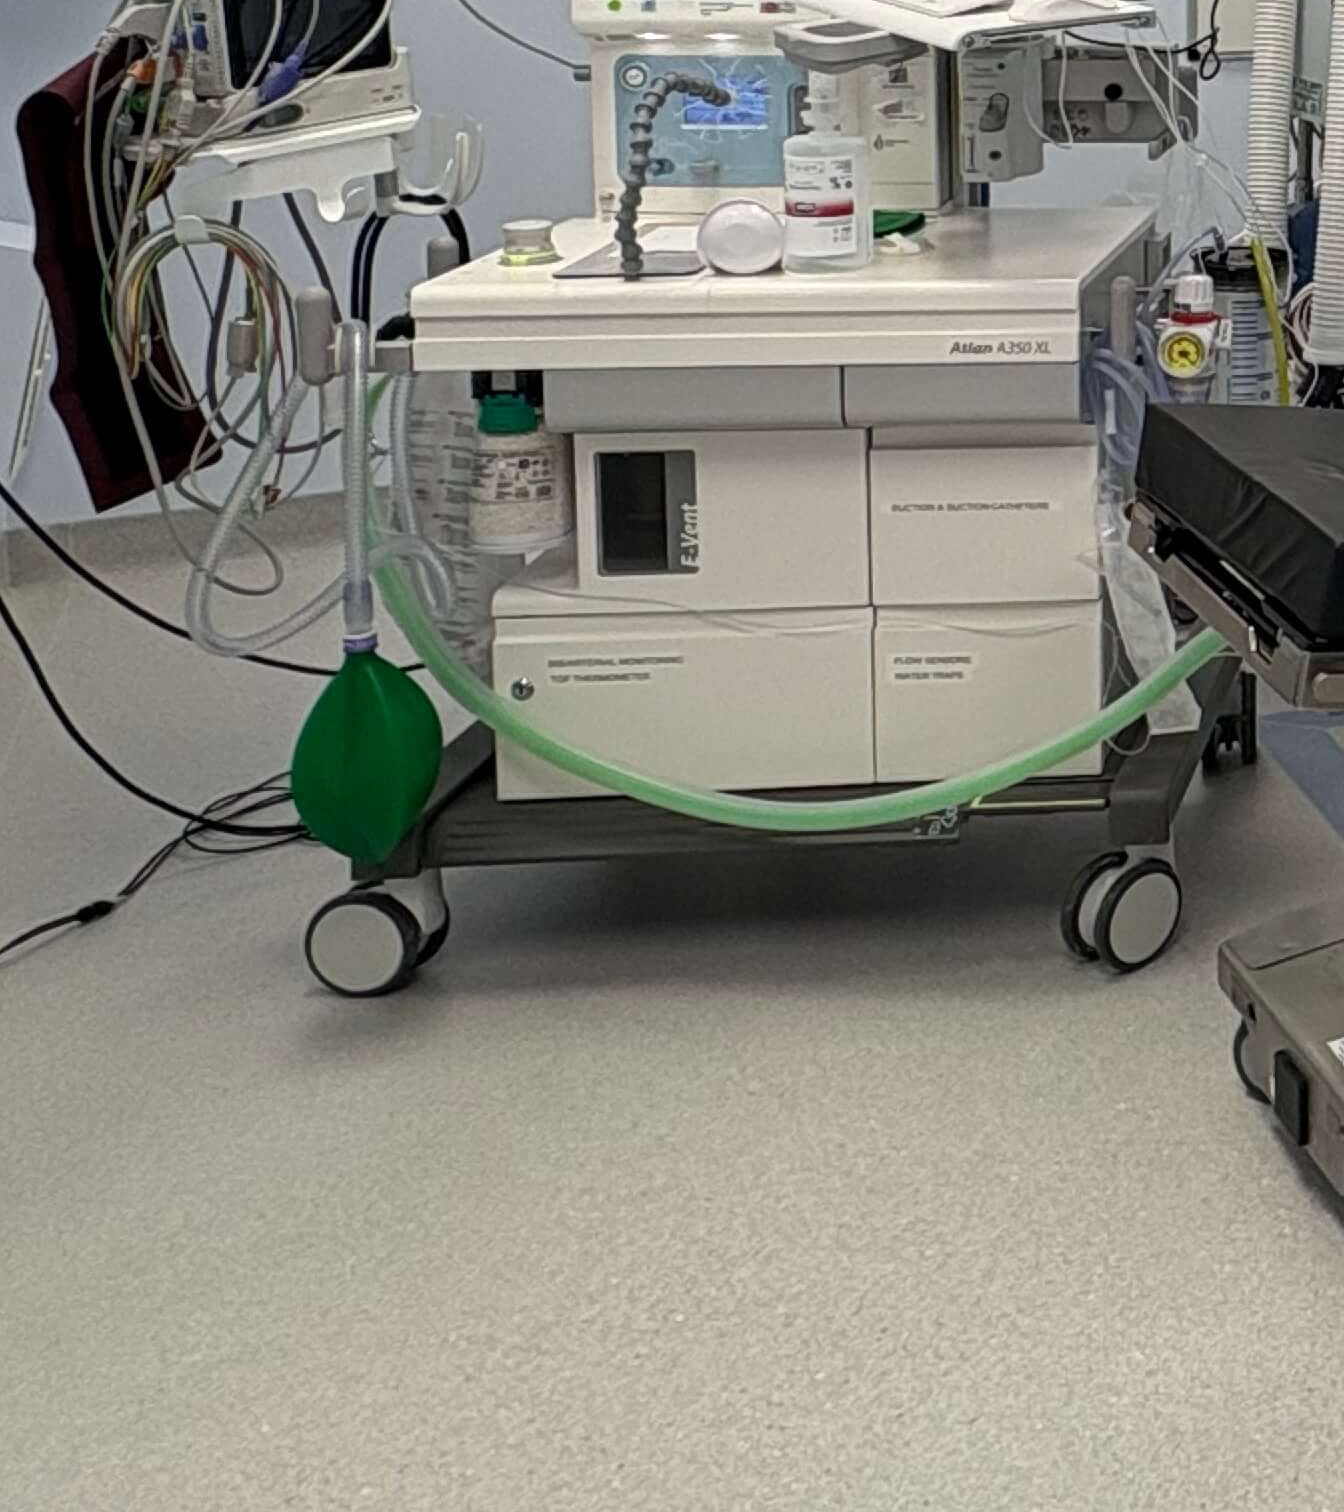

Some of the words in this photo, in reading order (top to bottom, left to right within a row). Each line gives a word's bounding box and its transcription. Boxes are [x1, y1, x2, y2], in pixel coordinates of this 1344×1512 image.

[949, 341, 994, 355] Atlan
[997, 341, 1032, 355] A350
[1033, 341, 1052, 355] XL
[680, 502, 702, 567] E-Vent
